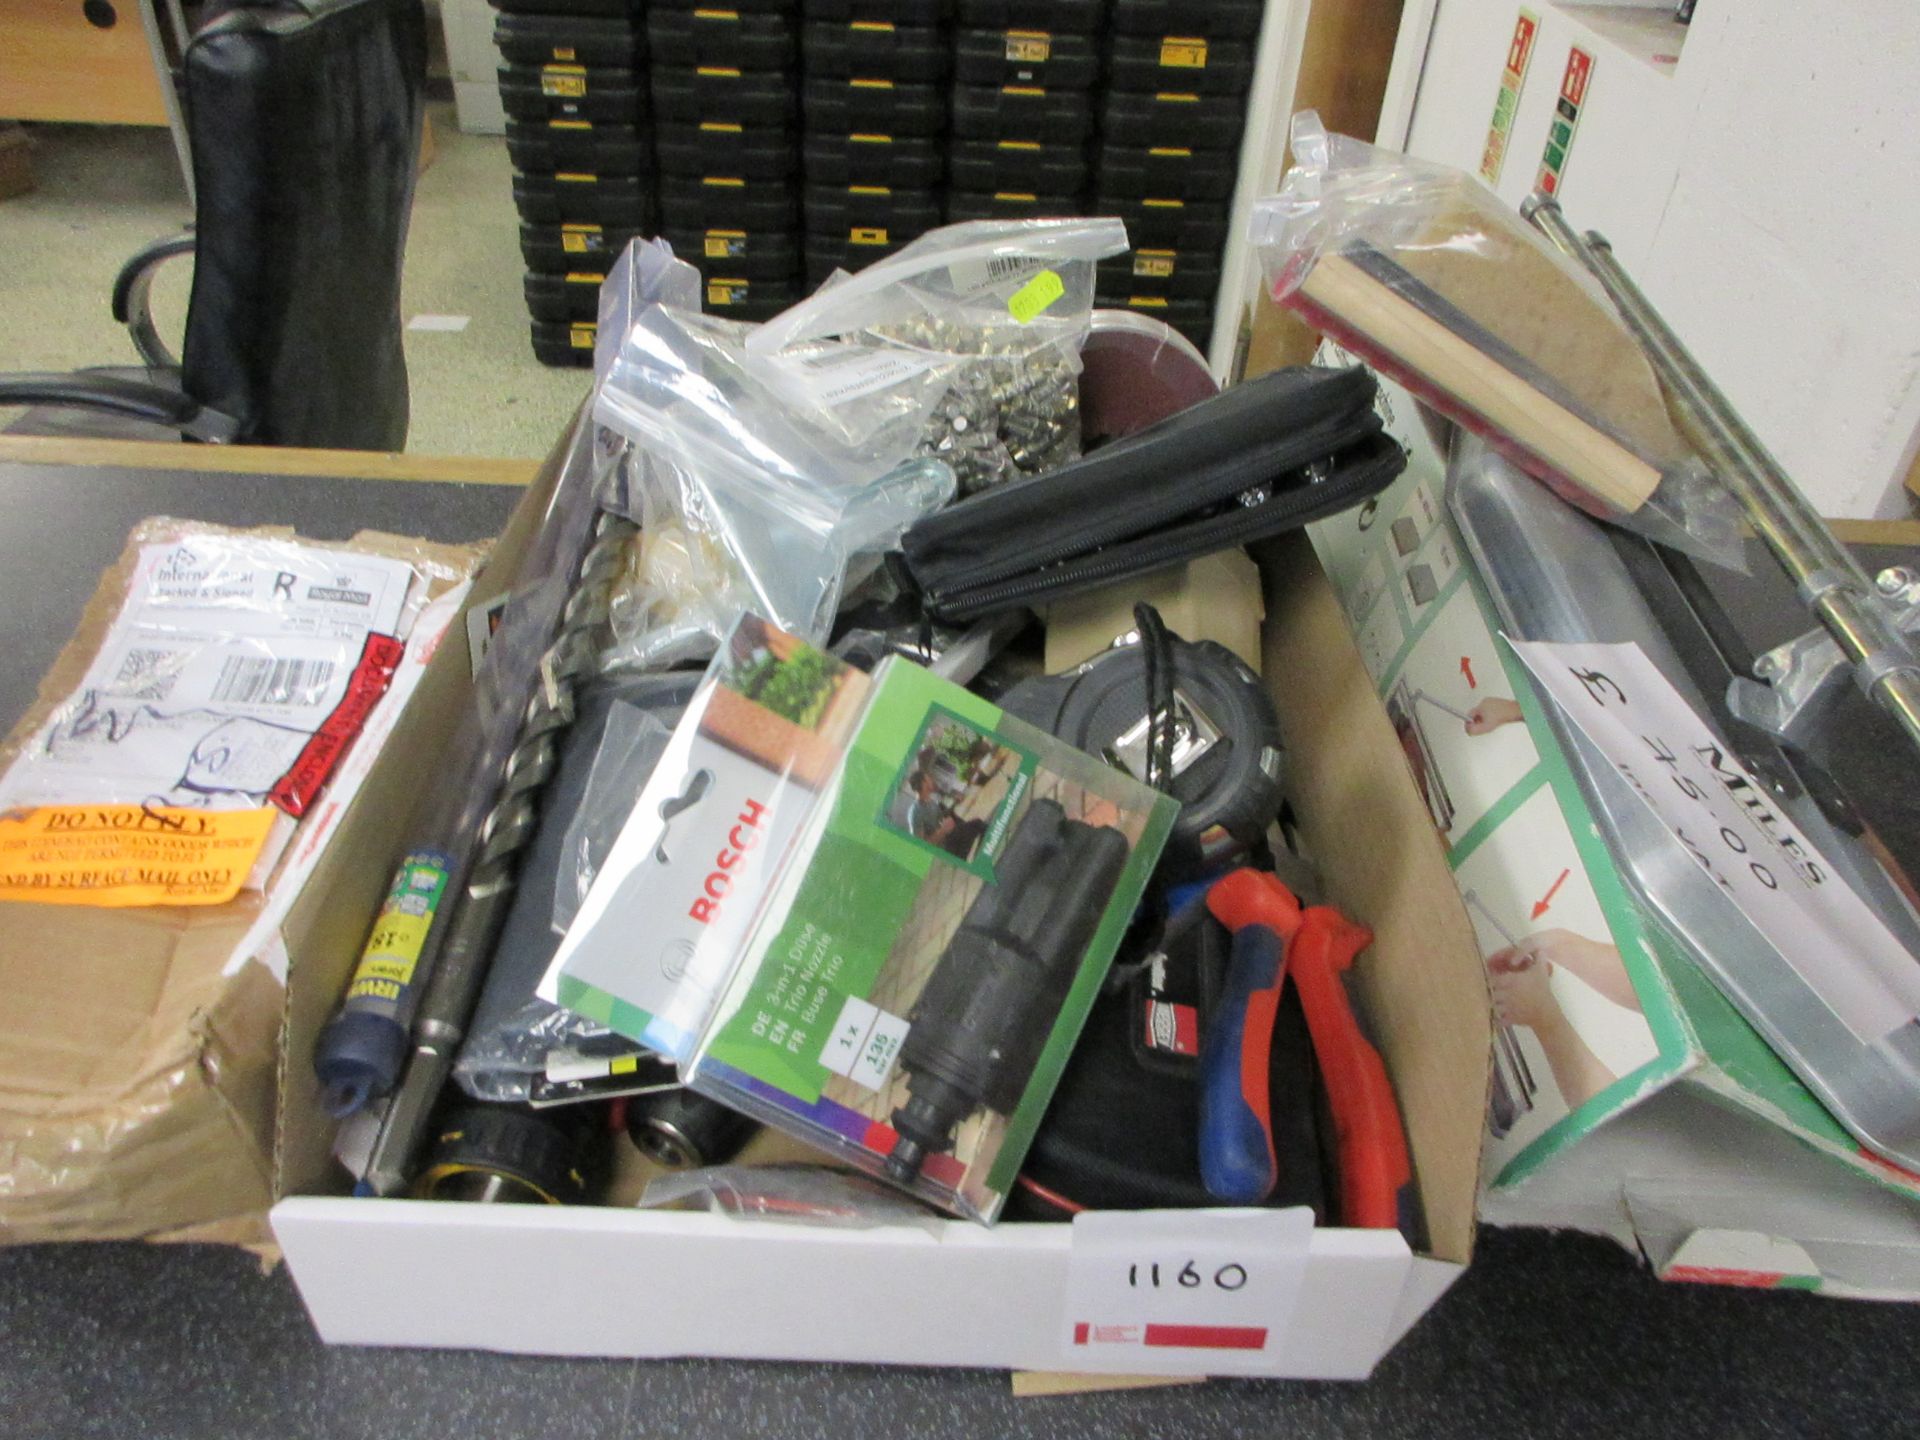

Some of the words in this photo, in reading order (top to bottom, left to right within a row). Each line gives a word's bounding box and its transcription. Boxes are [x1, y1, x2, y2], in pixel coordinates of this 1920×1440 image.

[272, 571, 298, 602] R
[46, 811, 87, 829] DO
[1694, 741, 1827, 885] MILES
[688, 797, 766, 924] BOSCH
[57, 867, 132, 888] SURFACE
[136, 867, 180, 884] MAIL
[187, 867, 233, 884] ONLY
[768, 1020, 790, 1046] EN
[784, 985, 807, 1014] Trio
[801, 933, 832, 984] Nozzle
[786, 1029, 807, 1054] FR
[801, 986, 829, 1024] Buse
[822, 954, 845, 984] Trio
[752, 1010, 773, 1038] DE
[866, 1033, 889, 1066] 135
[1128, 1259, 1248, 1291] 1160
